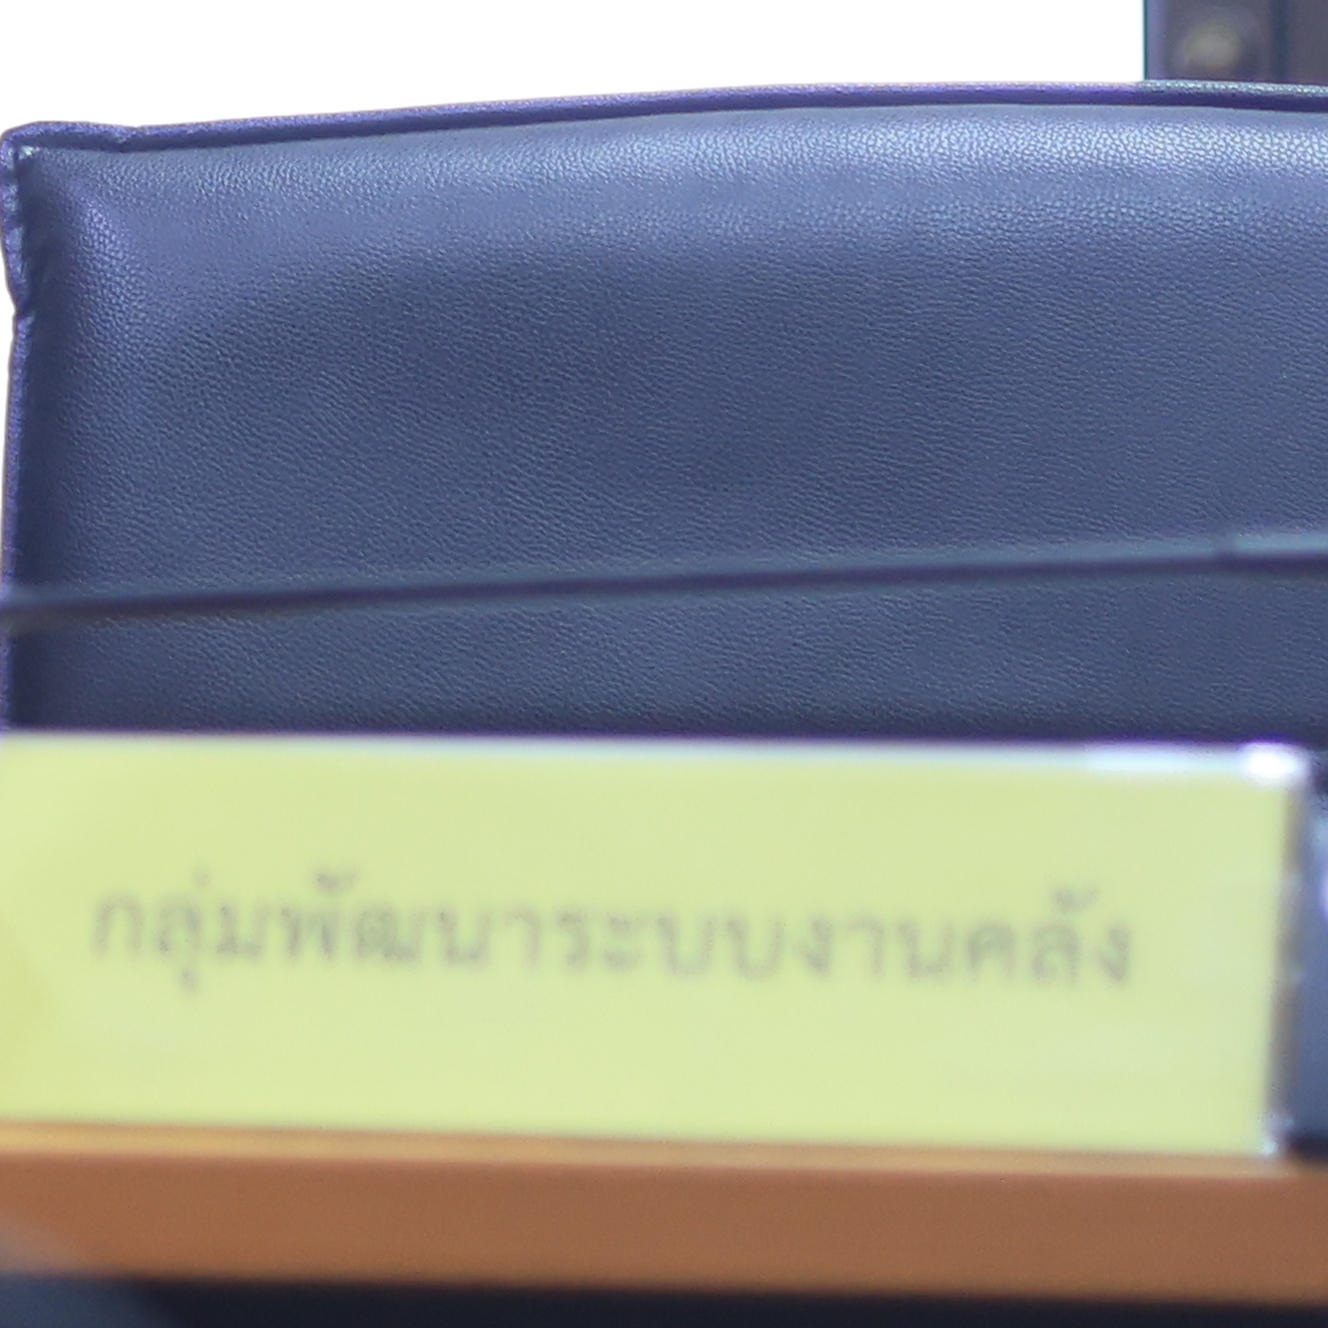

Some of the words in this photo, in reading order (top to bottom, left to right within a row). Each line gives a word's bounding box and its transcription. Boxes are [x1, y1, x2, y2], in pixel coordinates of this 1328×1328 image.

[92, 866, 1134, 994] กลุ่มพัฒนาระบบงานคลัง
